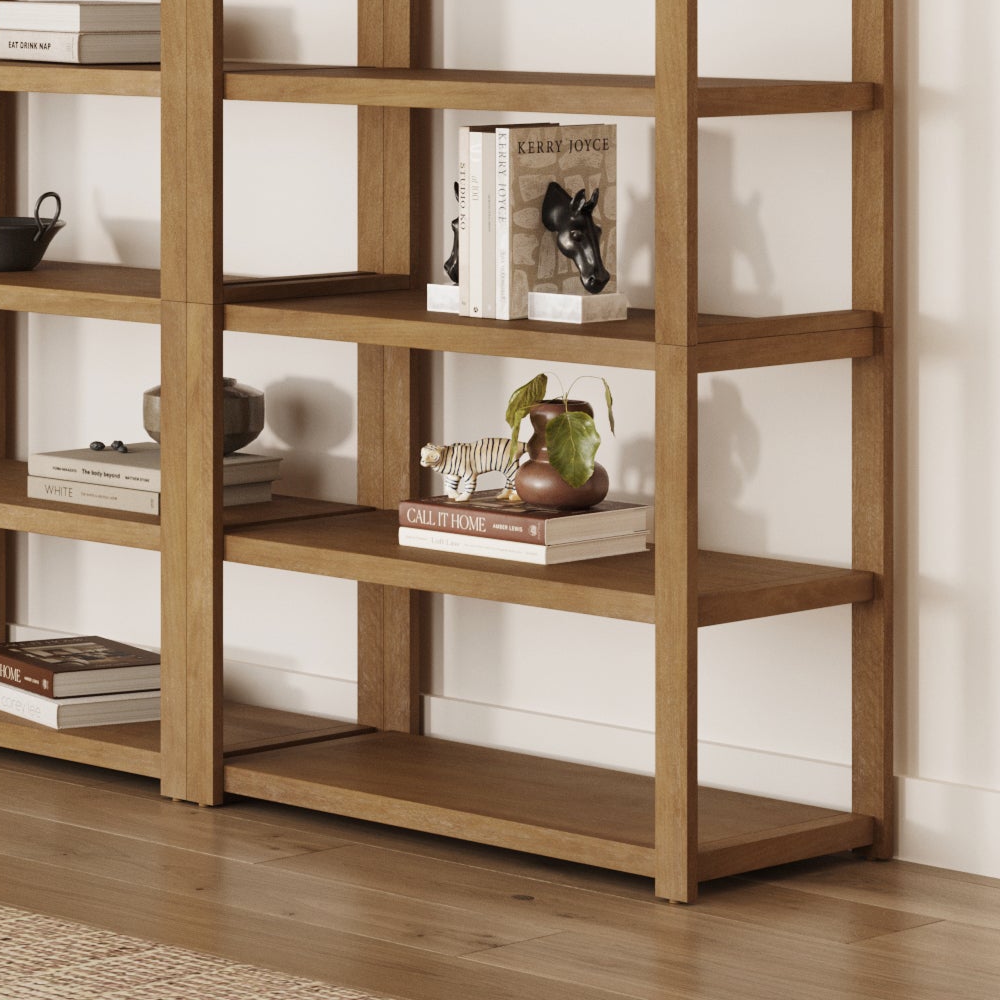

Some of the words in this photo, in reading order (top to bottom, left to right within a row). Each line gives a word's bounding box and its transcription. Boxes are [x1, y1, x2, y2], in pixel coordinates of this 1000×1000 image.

[8, 41, 18, 49] EAT
[20, 42, 38, 50] DRINK
[39, 42, 52, 50] NAP
[498, 133, 507, 177] KERRY
[518, 140, 563, 154] KERRY
[568, 138, 610, 154] JOYCE
[498, 184, 507, 223] JOYCE
[44, 484, 73, 498] WHITE
[406, 507, 436, 526] CALL
[438, 511, 449, 528] IT
[451, 513, 487, 532] HOME
[0, 664, 22, 683] HOME
